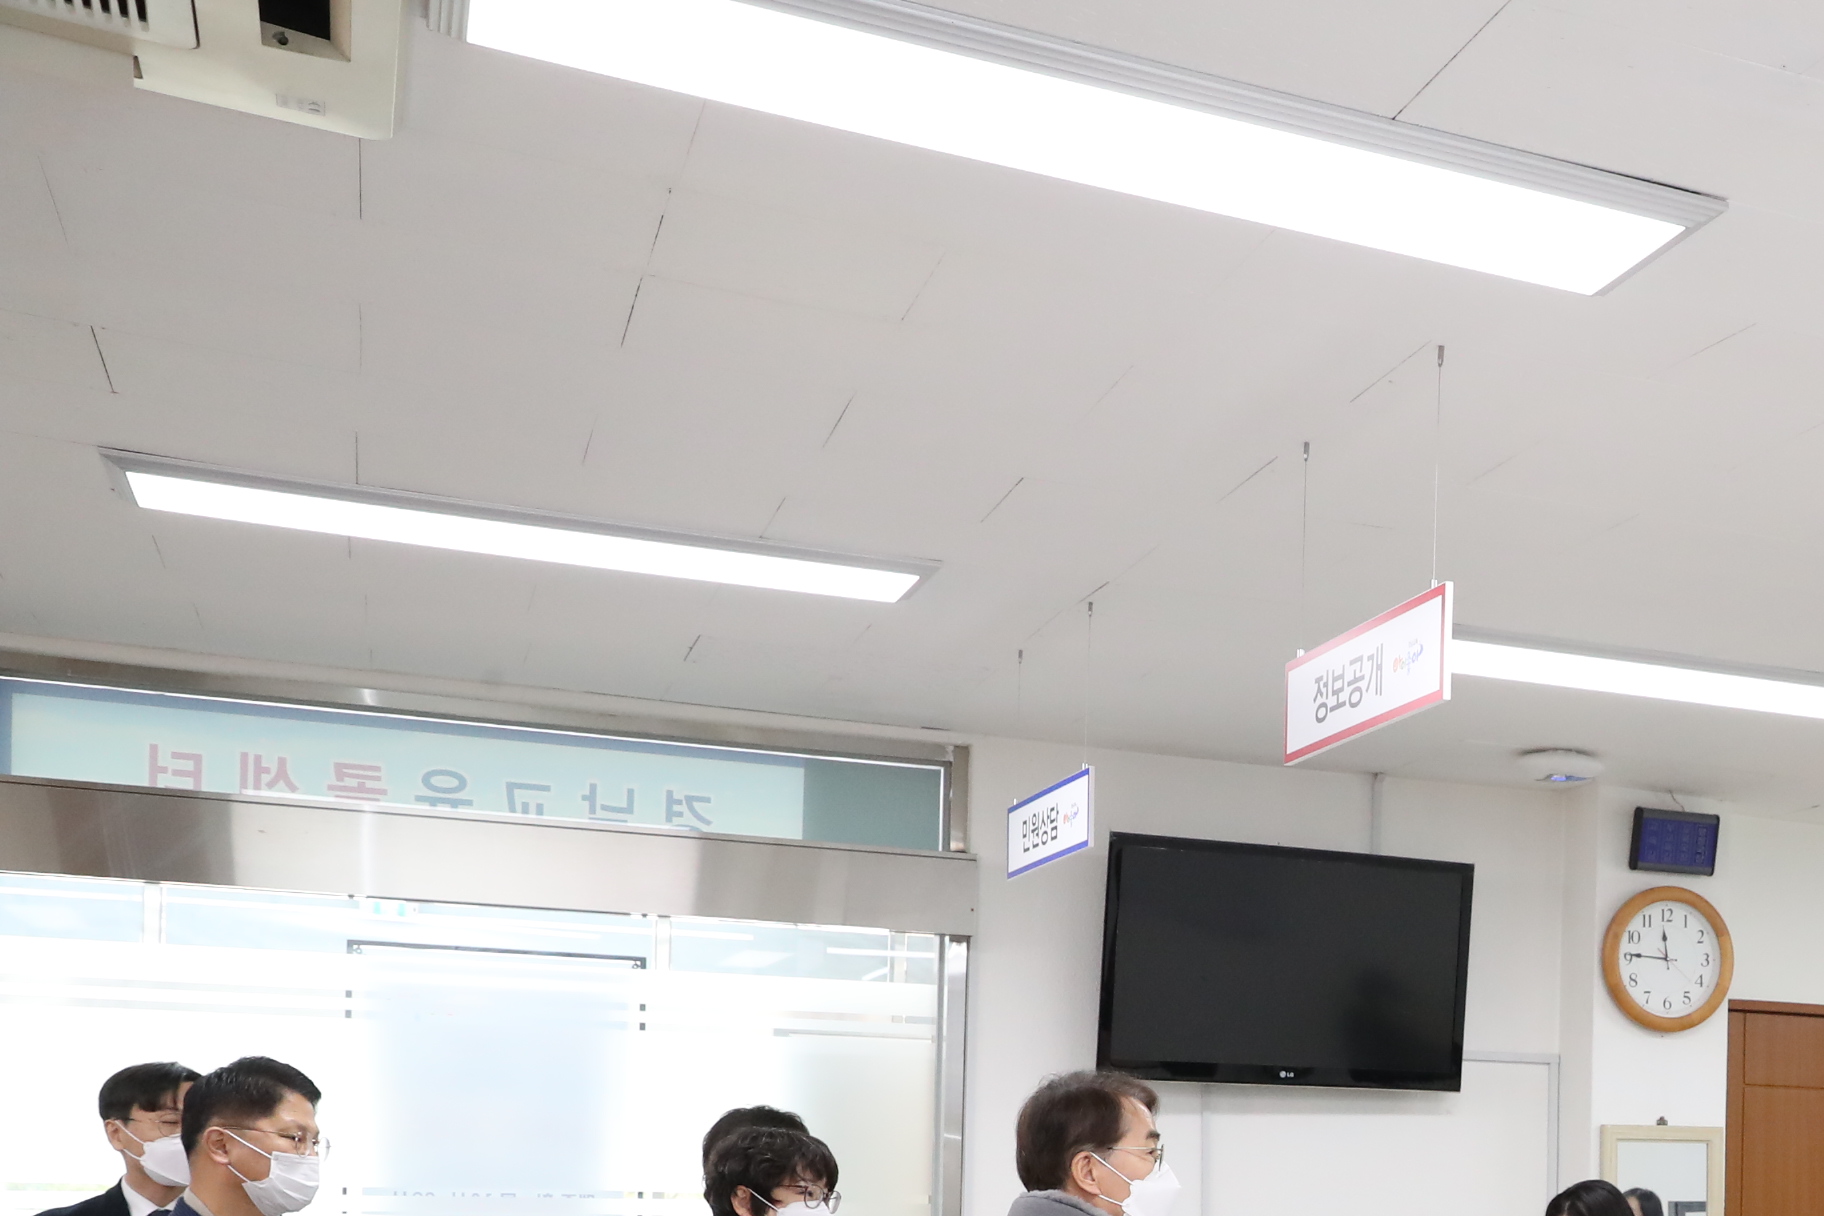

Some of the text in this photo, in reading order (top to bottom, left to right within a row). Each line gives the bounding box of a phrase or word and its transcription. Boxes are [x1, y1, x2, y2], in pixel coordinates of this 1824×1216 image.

[1313, 643, 1384, 724] 정보공개
[1022, 803, 1059, 853] 민원상담
[1642, 914, 1652, 928] 11
[1661, 908, 1673, 922] 12
[1627, 930, 1641, 944] 10
[1697, 930, 1704, 944] 2
[1624, 952, 1633, 966] 9
[1701, 953, 1710, 967] 3
[1628, 972, 1638, 987] 8
[1694, 974, 1703, 987] 4
[1643, 991, 1651, 1004] 7
[1663, 996, 1672, 1010] 6
[1682, 991, 1691, 1005] 5
